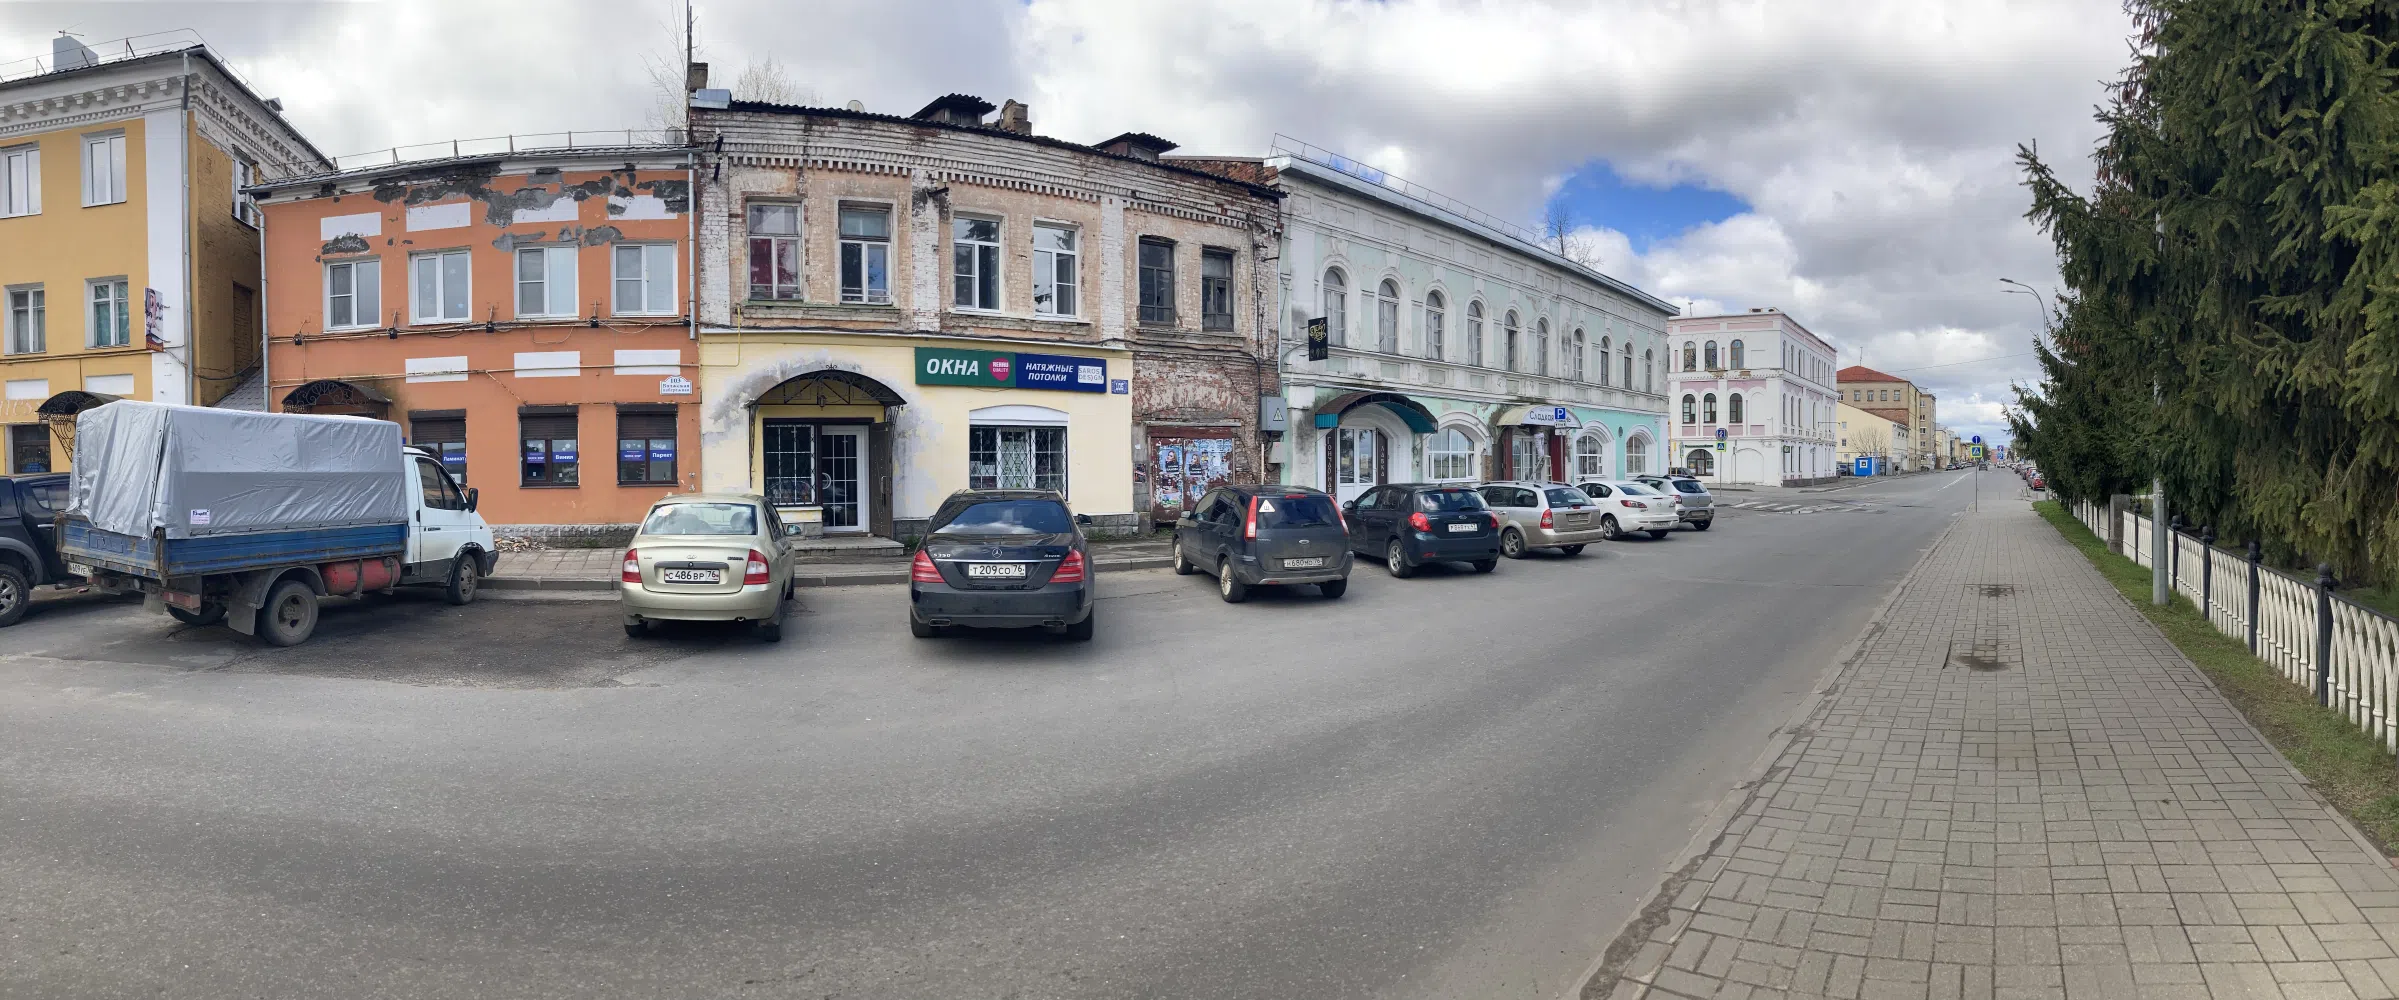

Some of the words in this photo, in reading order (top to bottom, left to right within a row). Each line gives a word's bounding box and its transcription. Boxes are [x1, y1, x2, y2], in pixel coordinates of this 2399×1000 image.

[926, 358, 979, 376] ОКНА
[1025, 362, 1074, 373] НАТЯЖНЫЕ
[1028, 373, 1067, 382] ПОТОЛКИ
